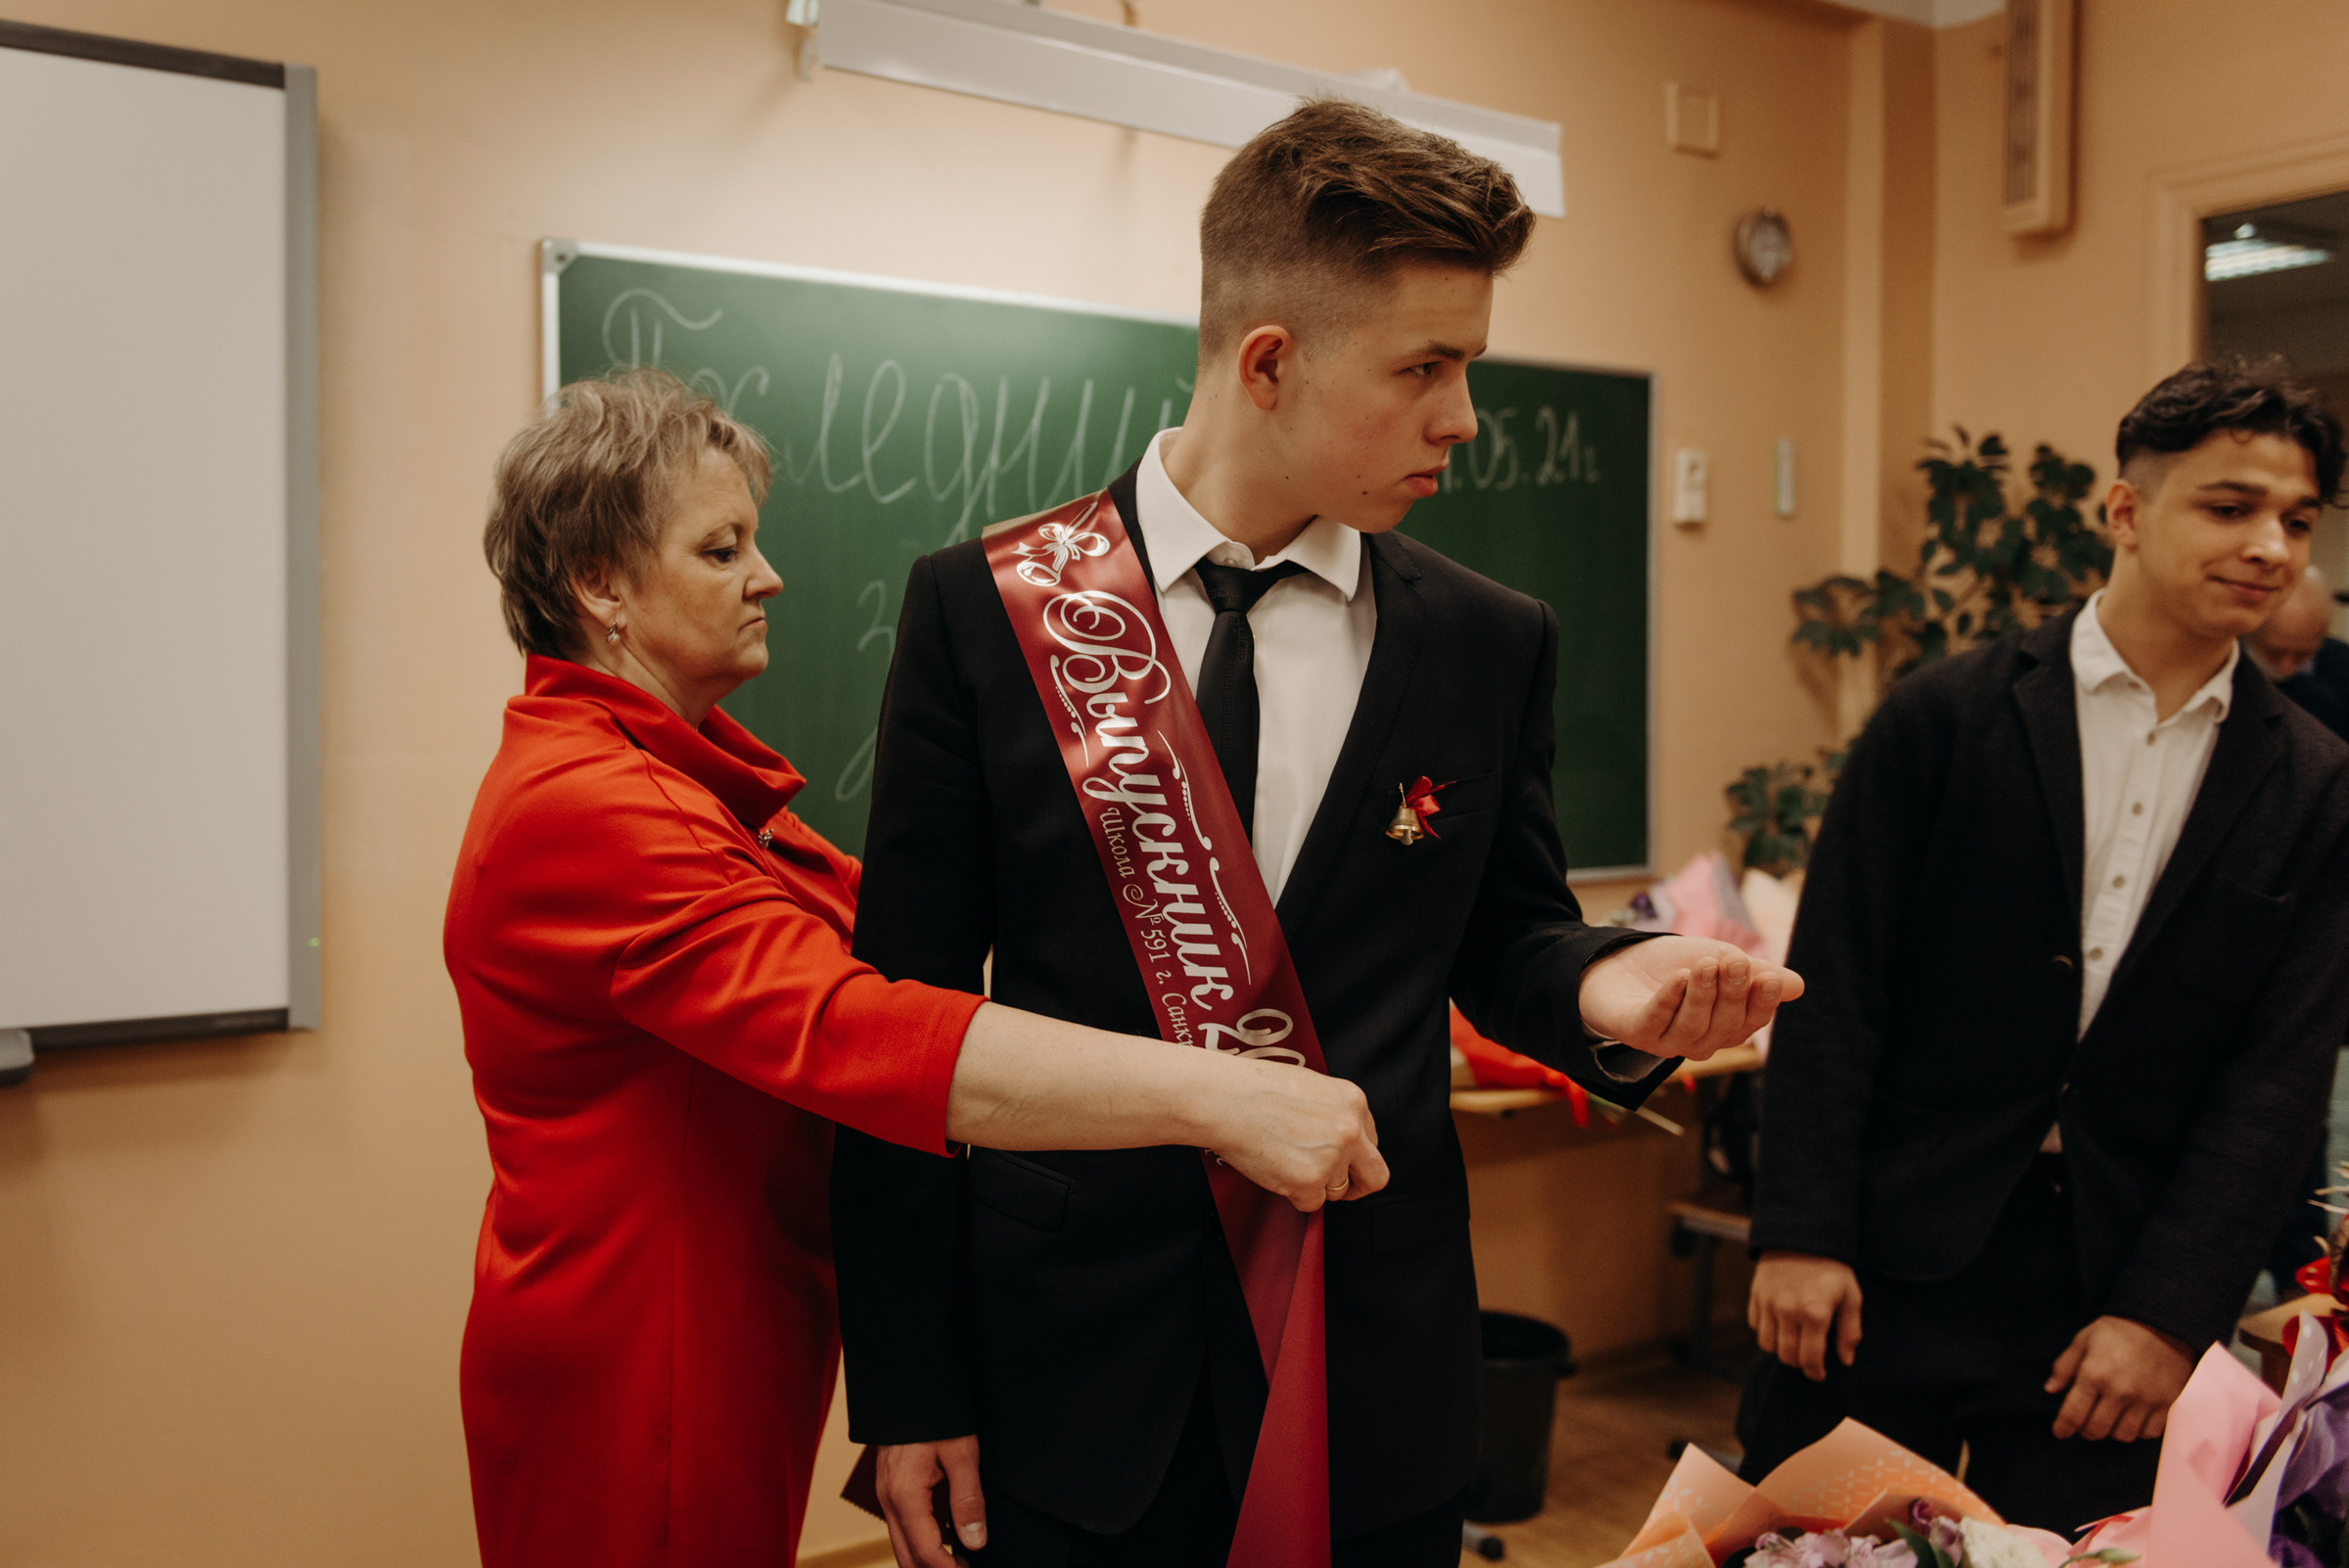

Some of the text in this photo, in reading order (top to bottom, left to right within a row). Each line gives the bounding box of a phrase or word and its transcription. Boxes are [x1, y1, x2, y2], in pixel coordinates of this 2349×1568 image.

[1042, 589, 1234, 1012] Выпускник
[1099, 807, 1135, 879] Школа
[1122, 883, 1165, 926] №
[1140, 929, 1172, 963] 591
[1155, 970, 1173, 985] г.
